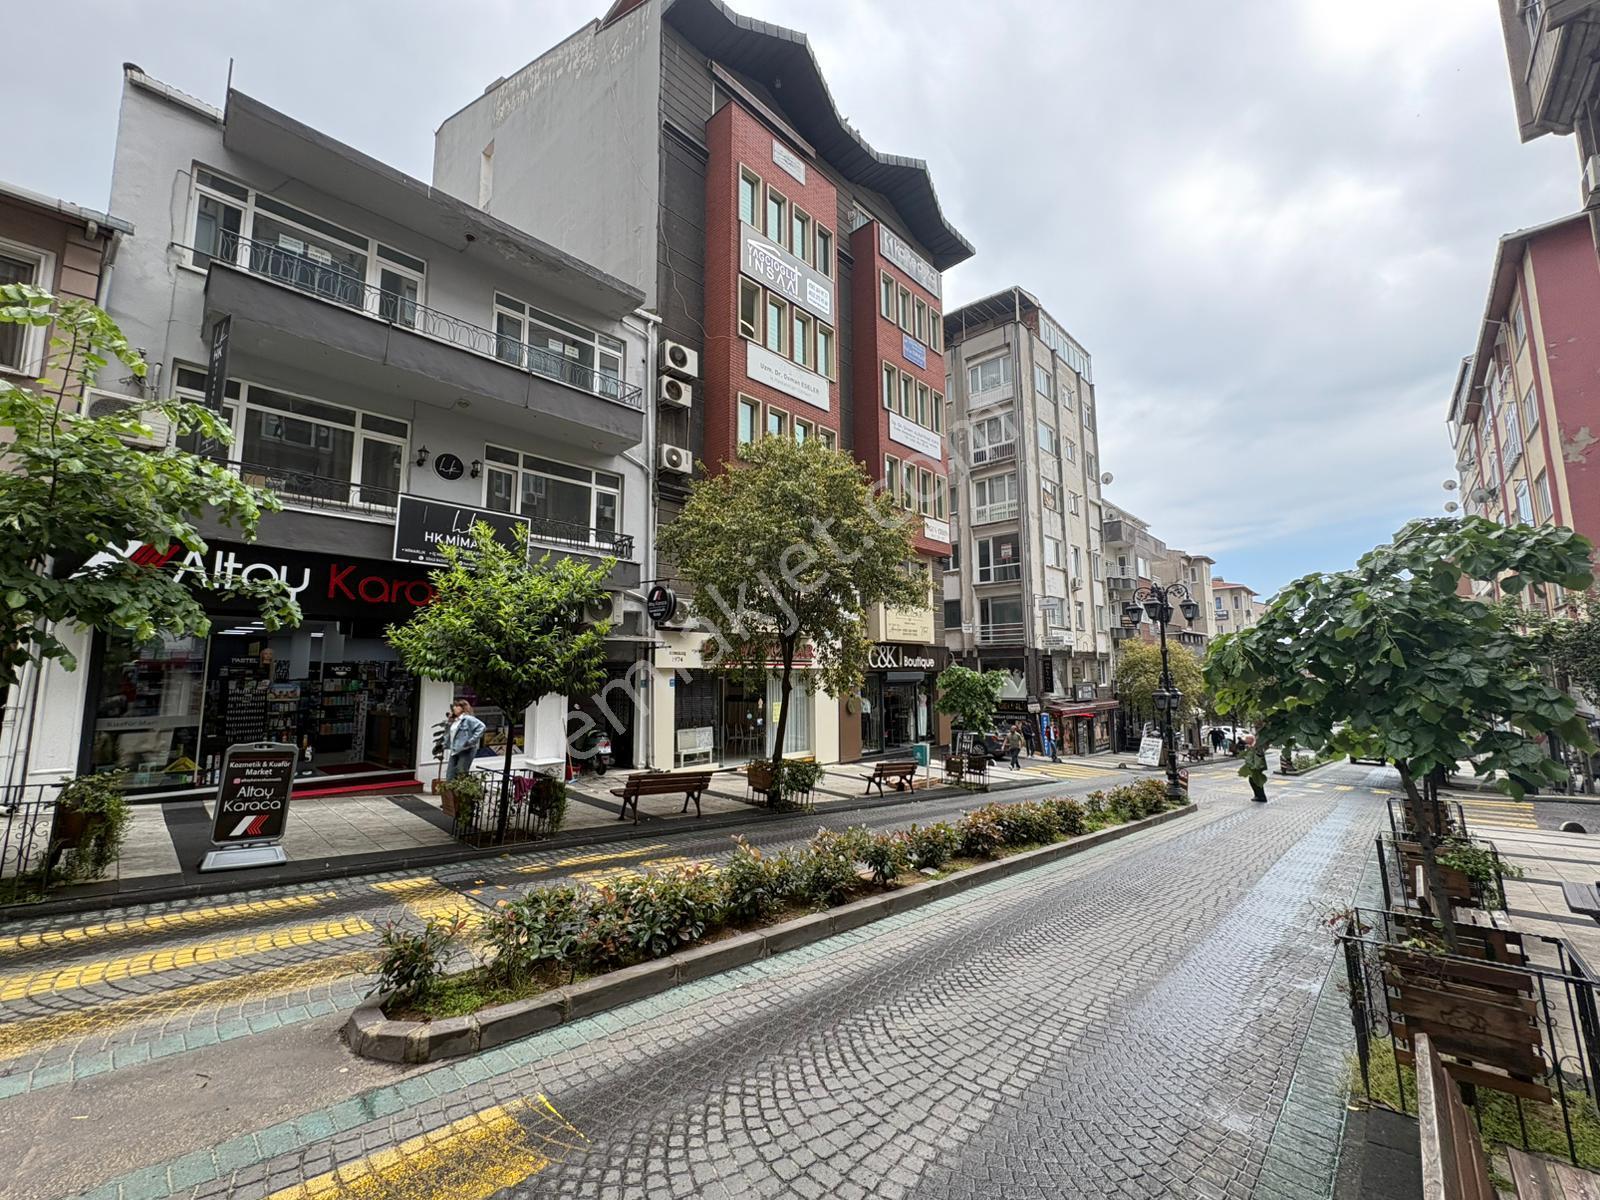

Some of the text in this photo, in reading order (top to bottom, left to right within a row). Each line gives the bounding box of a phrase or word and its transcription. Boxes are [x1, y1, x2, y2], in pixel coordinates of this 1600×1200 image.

[424, 531, 478, 548] HK MİMA
[172, 550, 442, 607] Altay Kara
[868, 645, 935, 669] C&K Boutique
[229, 761, 261, 769] Kozmetik
[268, 760, 291, 768] Kuaför
[245, 768, 273, 776] Market
[236, 785, 275, 800] Altay
[223, 800, 282, 813] Karaca
